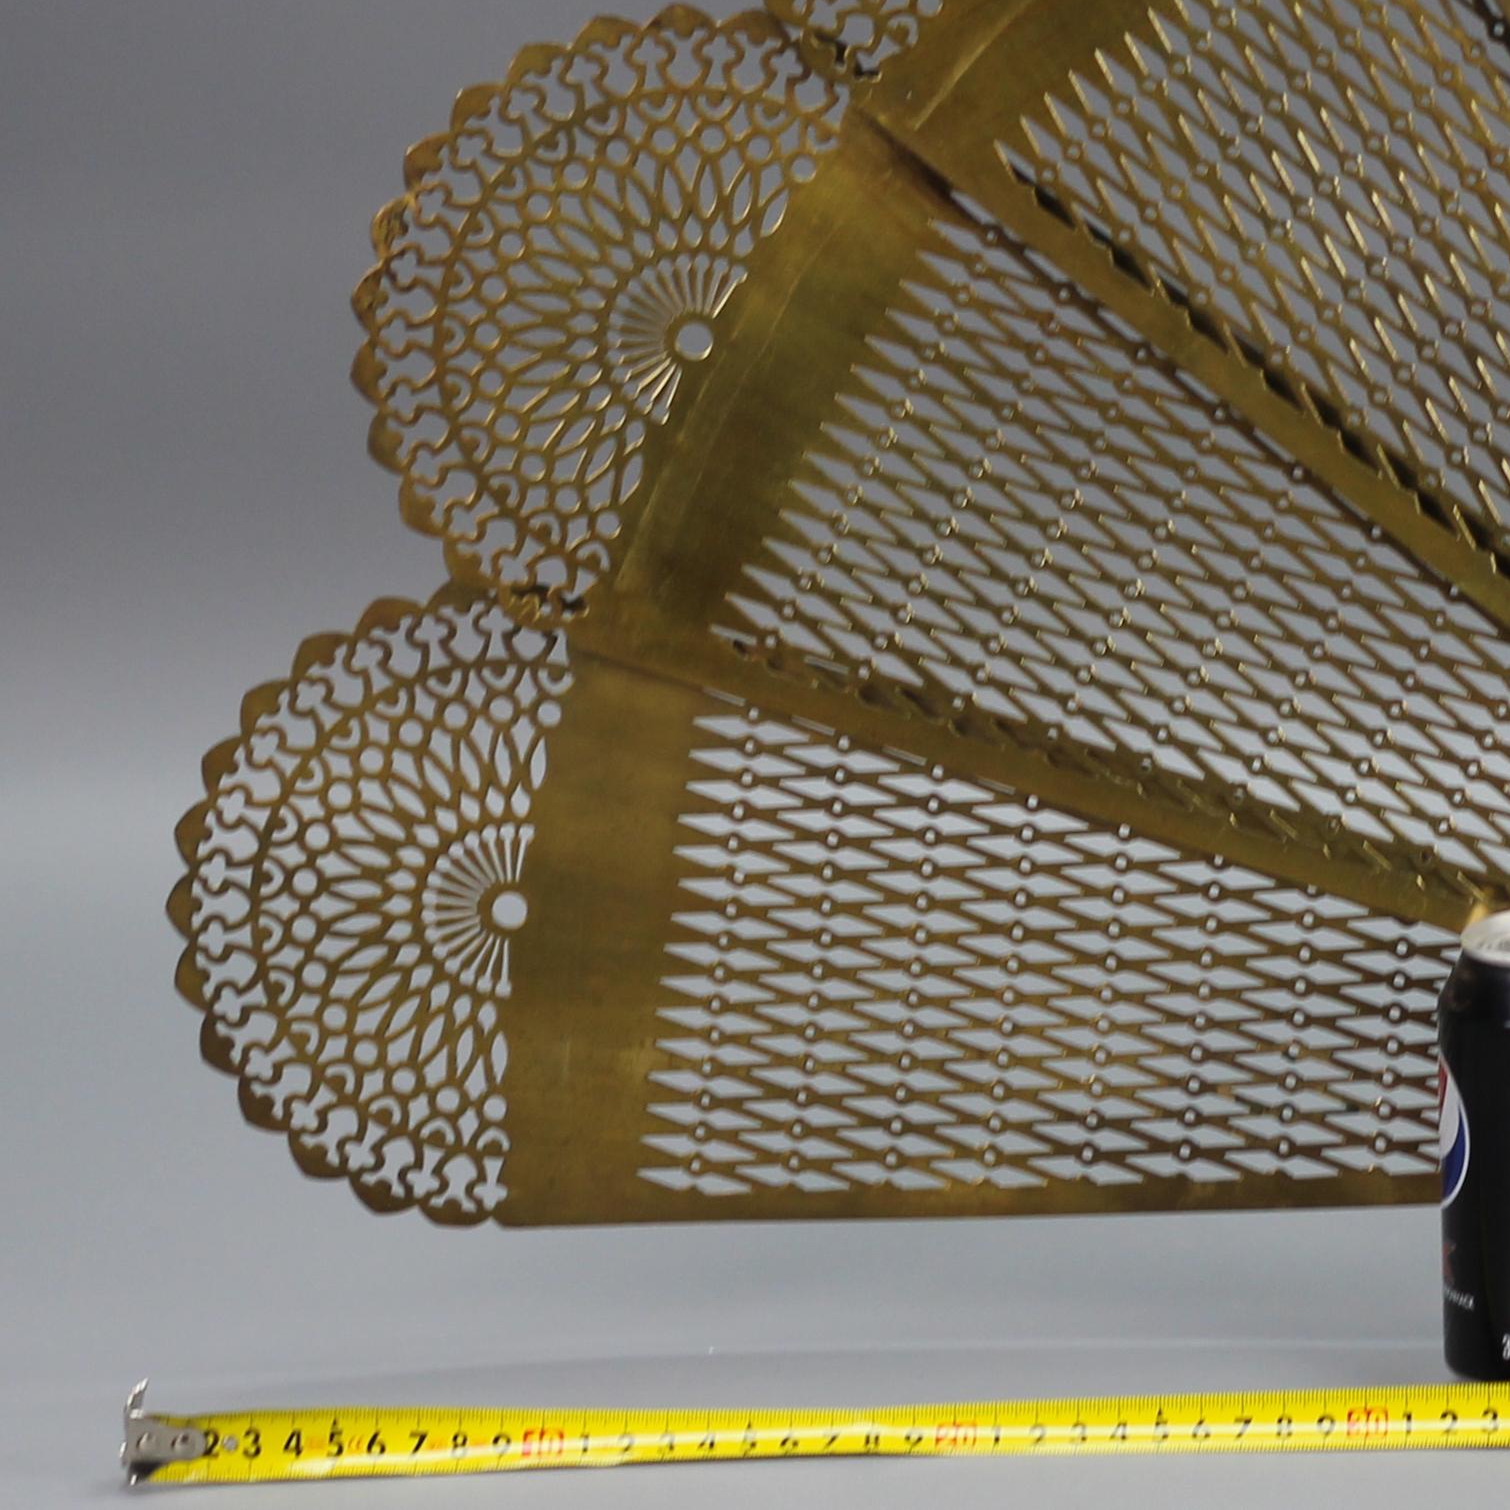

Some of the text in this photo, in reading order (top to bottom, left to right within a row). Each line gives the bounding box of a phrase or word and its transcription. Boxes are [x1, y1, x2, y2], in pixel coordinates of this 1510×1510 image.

[203, 1430, 219, 1459] 2
[243, 1427, 261, 1460] 3
[283, 1430, 303, 1458] 4
[328, 1430, 344, 1457] 5
[367, 1431, 386, 1455] 6
[410, 1432, 428, 1457] 7
[452, 1432, 468, 1457] 8
[492, 1432, 511, 1455] 9
[580, 1433, 590, 1454] 1
[697, 1431, 716, 1453] 4
[780, 1428, 800, 1449] 6
[904, 1426, 924, 1450] 9
[992, 1423, 1001, 1447] 1
[1029, 1423, 1047, 1447] 2
[1069, 1422, 1088, 1446] 3
[1108, 1421, 1129, 1443] 4
[1154, 1420, 1170, 1442] 5
[1192, 1418, 1211, 1441] 6
[1233, 1416, 1252, 1440] 7
[1276, 1415, 1292, 1439] 8
[1317, 1415, 1335, 1439] 9
[1403, 1411, 1412, 1436] 1
[1440, 1410, 1458, 1436] 2
[1482, 1409, 1498, 1435] 3
